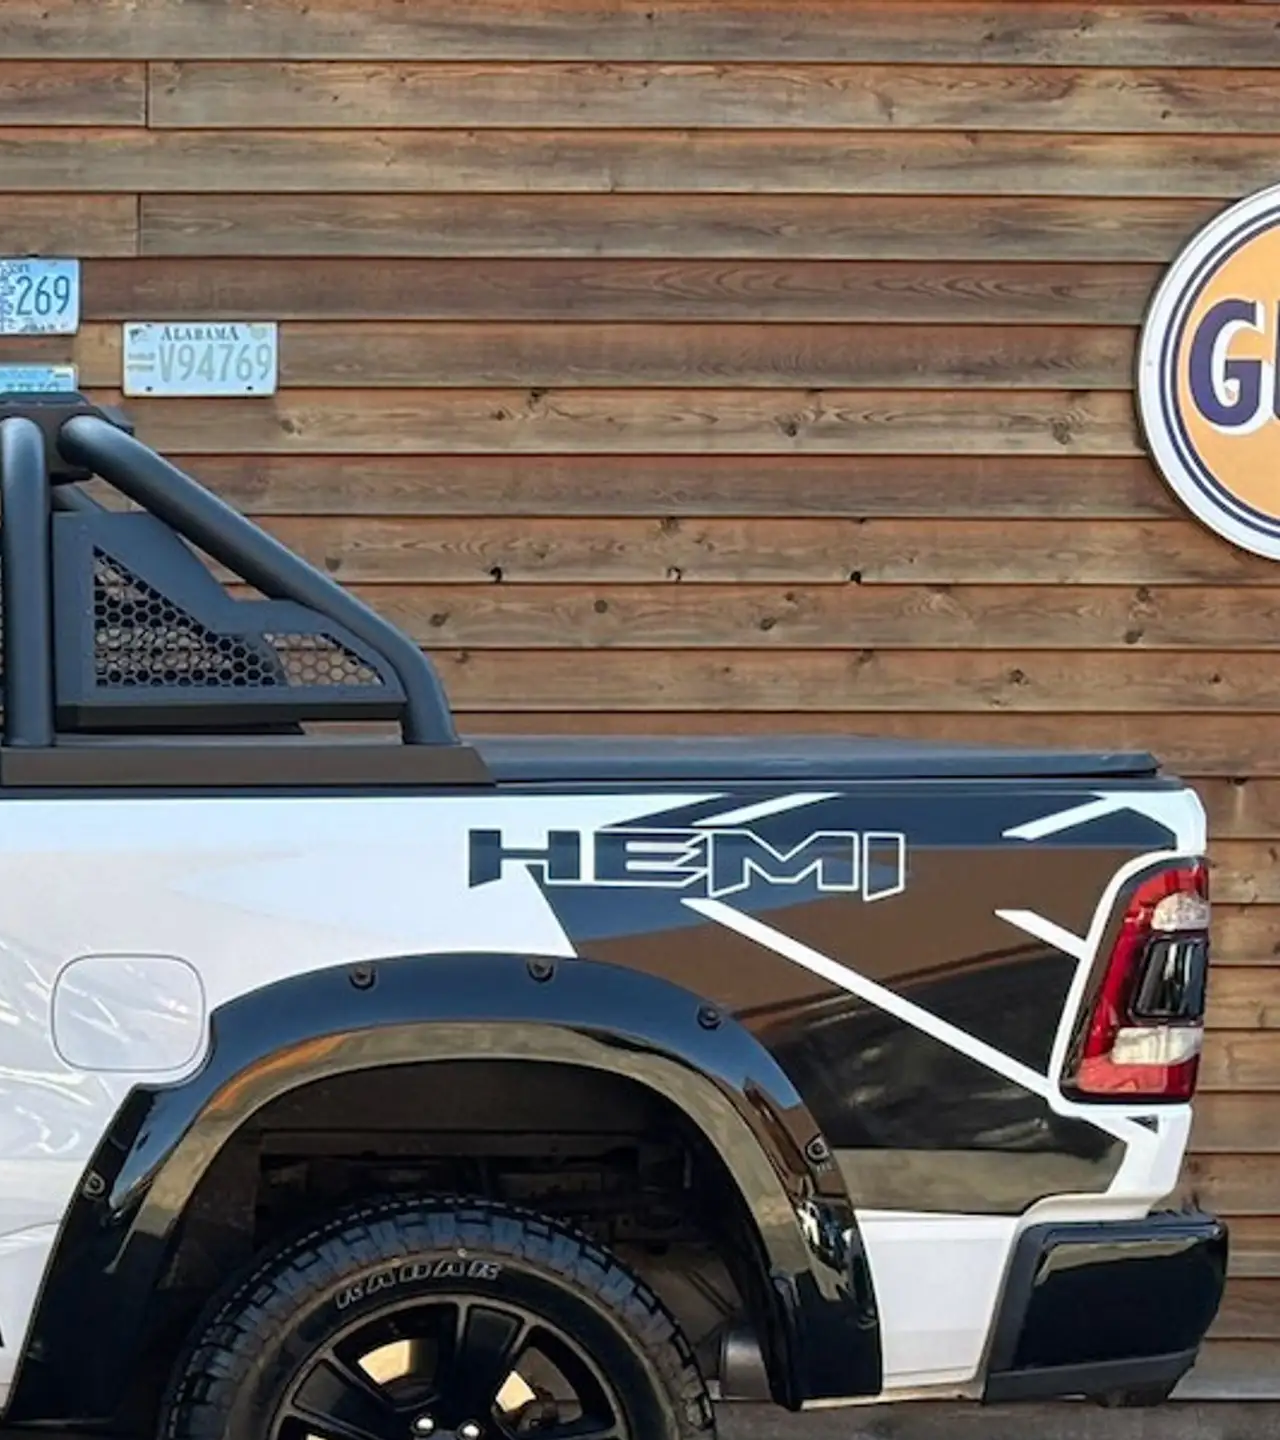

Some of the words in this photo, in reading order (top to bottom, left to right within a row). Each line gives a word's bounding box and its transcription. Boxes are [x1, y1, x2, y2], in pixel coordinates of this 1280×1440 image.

[16, 276, 71, 316] 269
[158, 343, 272, 383] V94769
[468, 828, 906, 901] HEMI
